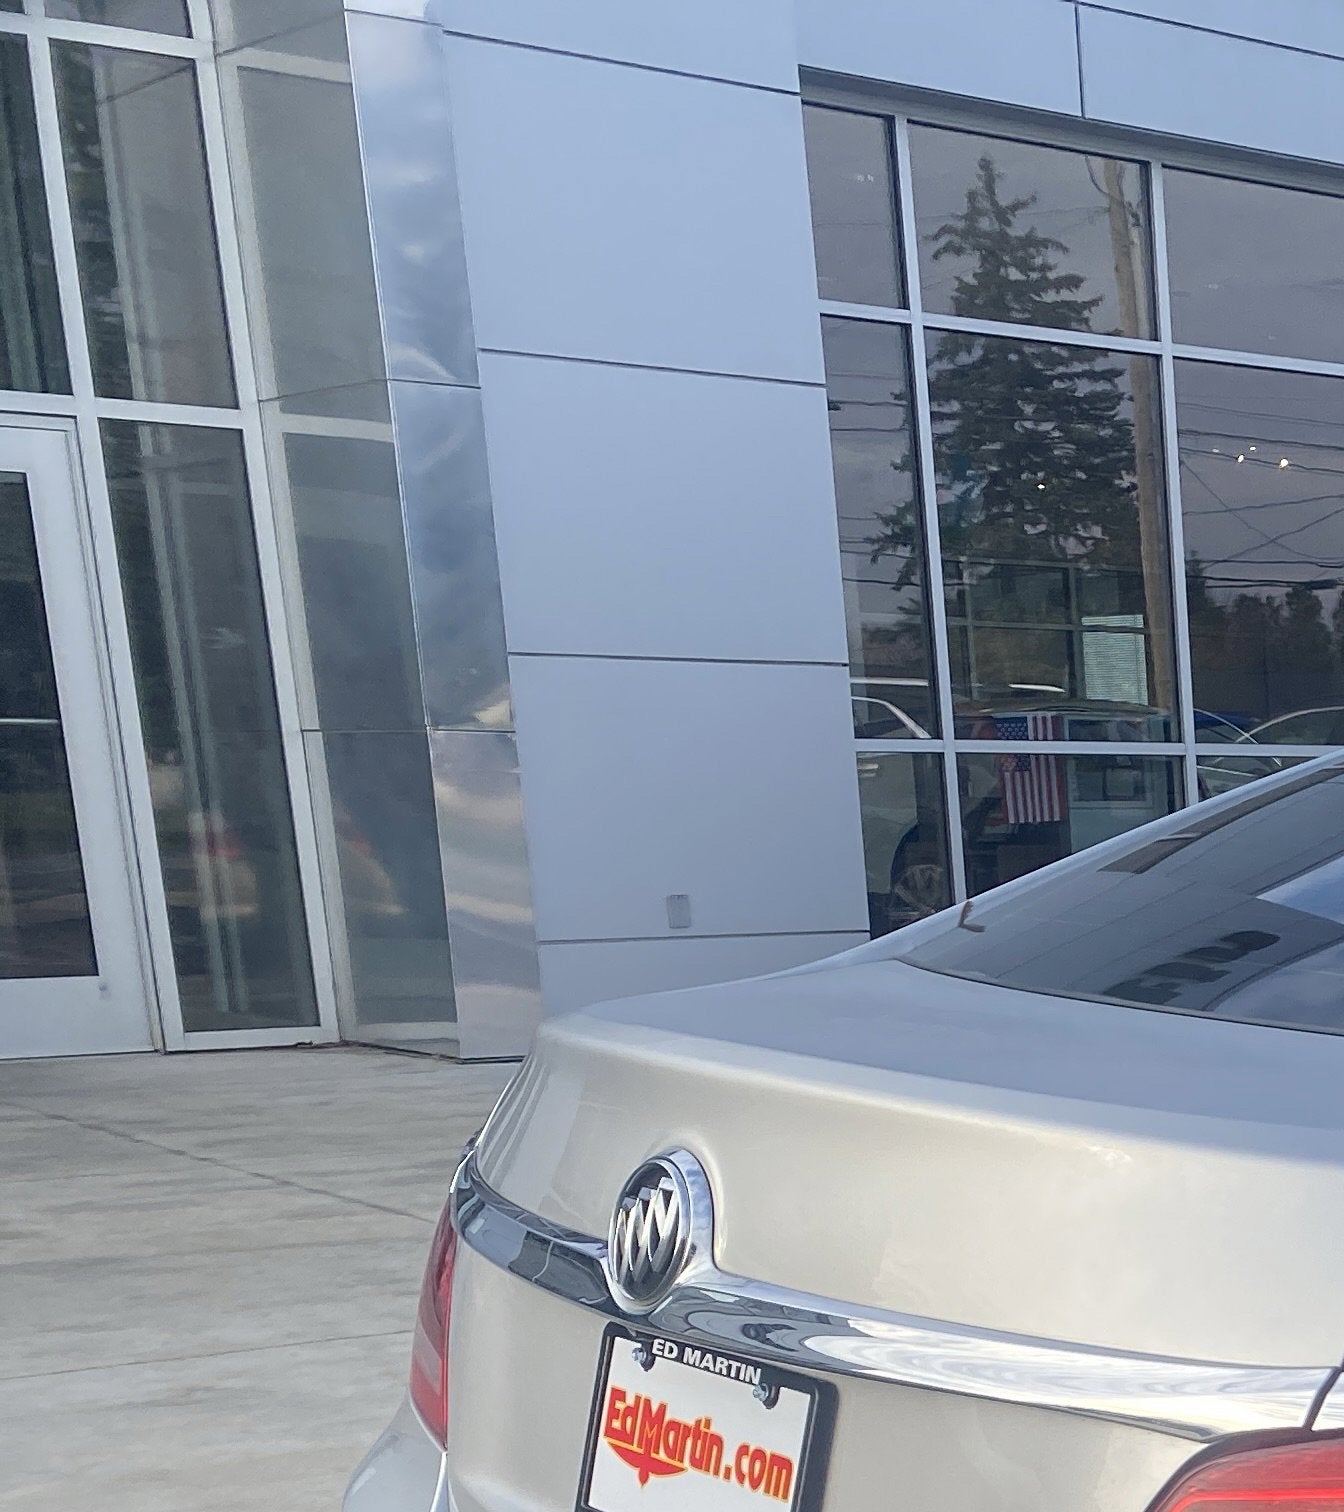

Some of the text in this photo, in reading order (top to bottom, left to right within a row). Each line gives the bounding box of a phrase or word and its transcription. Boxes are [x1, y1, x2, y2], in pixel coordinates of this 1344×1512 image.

[651, 1338, 763, 1386] ED MARTIN
[603, 1384, 794, 1503] EdMartin.com
